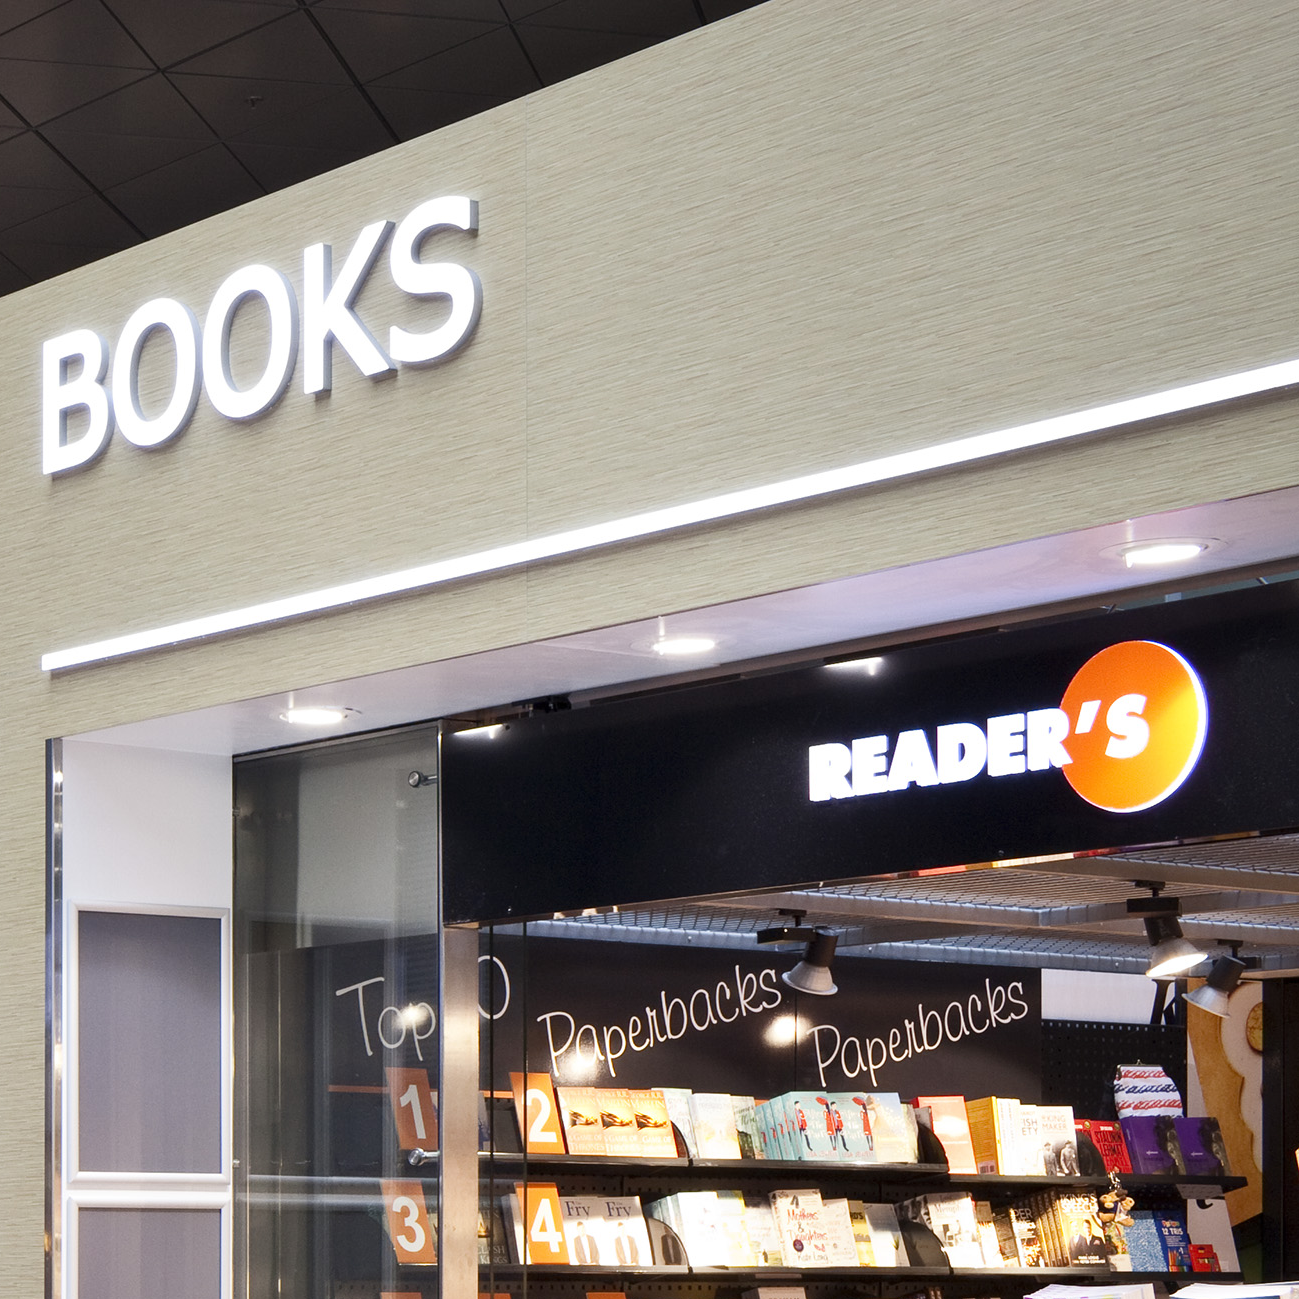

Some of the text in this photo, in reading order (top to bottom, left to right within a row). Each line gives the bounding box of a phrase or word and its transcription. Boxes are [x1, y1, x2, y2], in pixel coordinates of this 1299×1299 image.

[42, 196, 483, 475] BOOKS
[808, 694, 1150, 801] READER'S
[335, 976, 437, 1062] Top
[537, 965, 782, 1078] Paperbacks
[807, 978, 1029, 1088] Paperbacks
[399, 1085, 427, 1140] 1
[524, 1088, 557, 1143] 2
[391, 1196, 425, 1253] 3
[530, 1198, 563, 1253] 4
[565, 1201, 591, 1218] Fry
[607, 1202, 632, 1219] Fry
